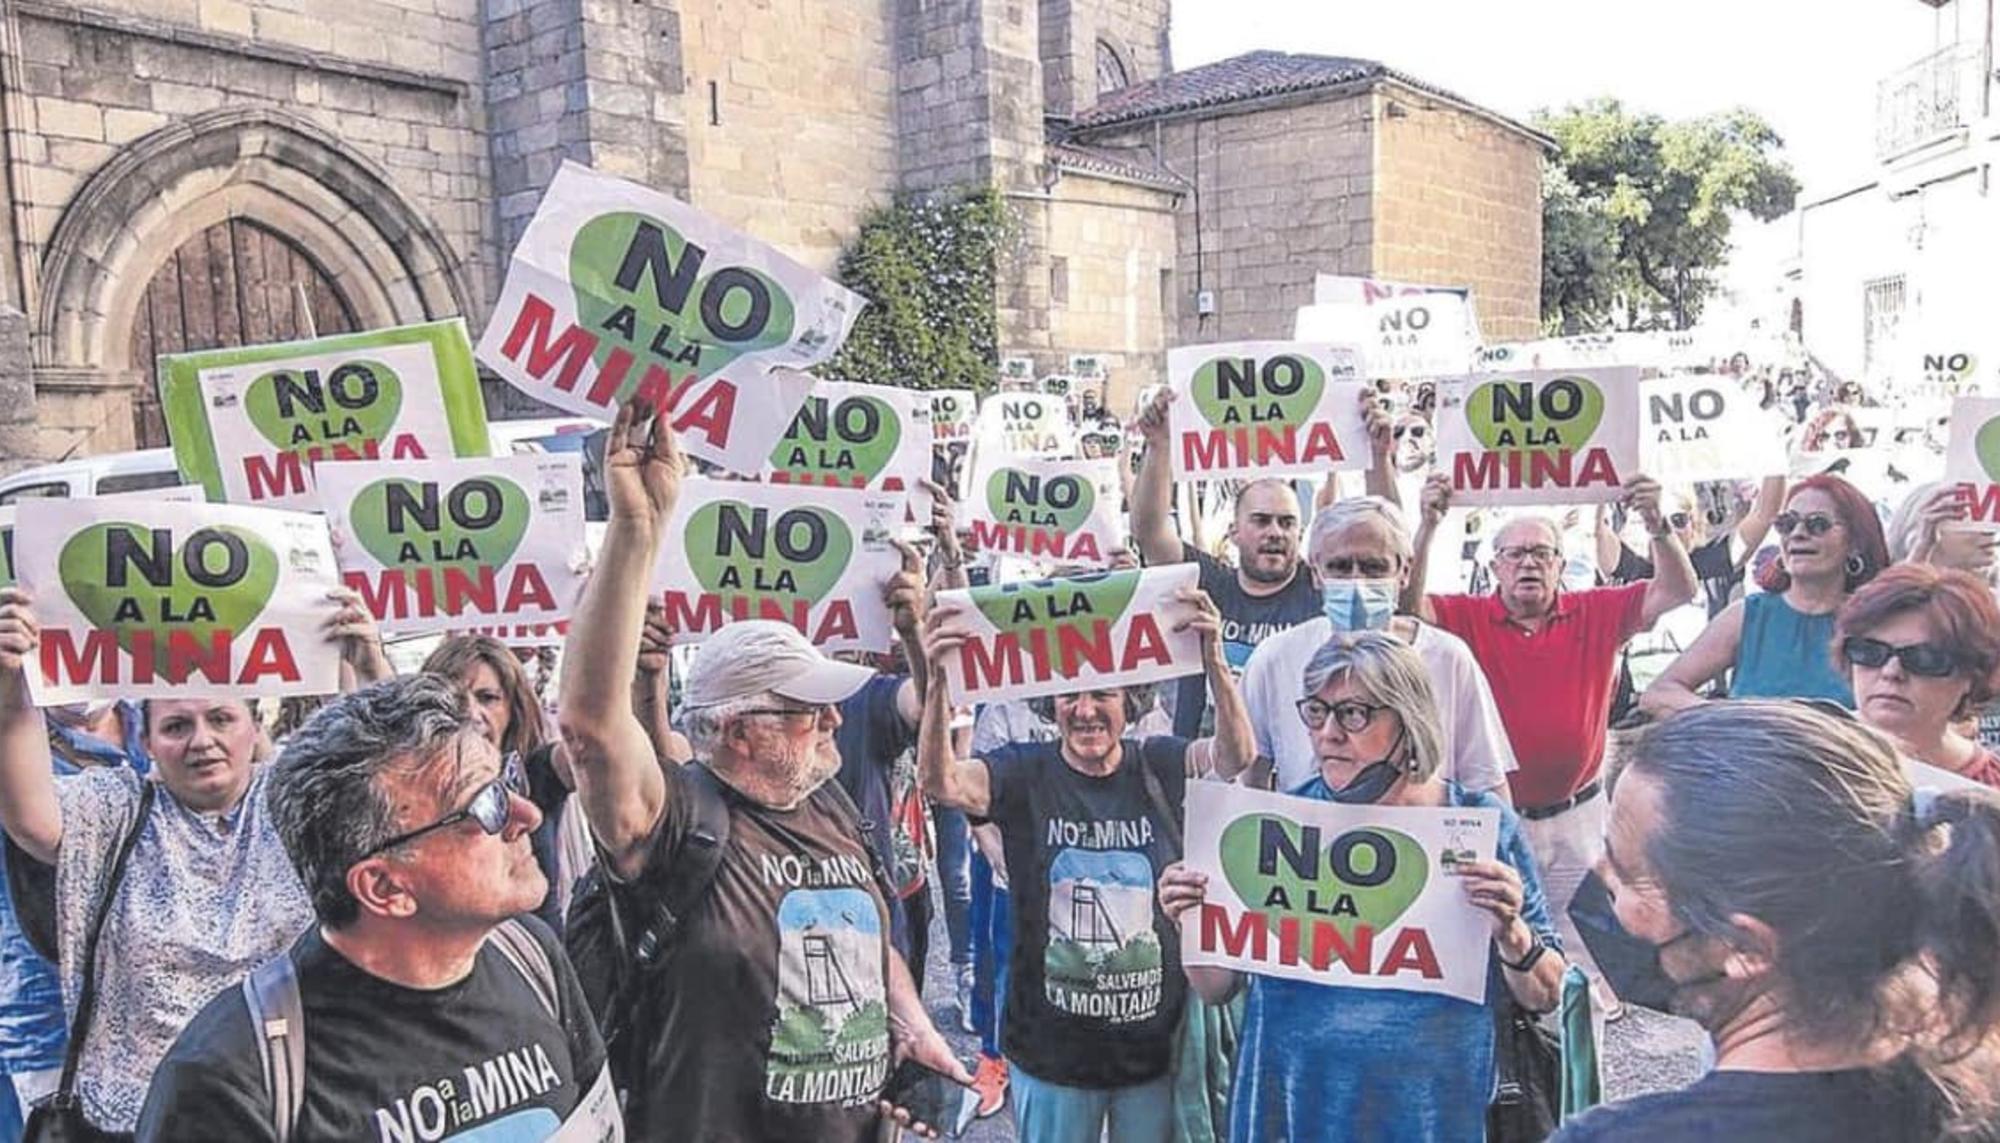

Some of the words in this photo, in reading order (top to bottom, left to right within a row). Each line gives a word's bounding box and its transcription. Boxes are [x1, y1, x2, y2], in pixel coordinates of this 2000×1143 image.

[614, 220, 771, 342] NO
[602, 305, 636, 341] A
[649, 323, 700, 368] LA
[1380, 306, 1430, 332] NO
[501, 293, 738, 450] MINA
[1482, 348, 1508, 362] NO
[1924, 353, 1969, 372] NO
[272, 364, 378, 418] NO
[1217, 353, 1304, 400] NO
[784, 396, 880, 444] NO
[1002, 401, 1042, 420] NO
[1223, 406, 1241, 424] A
[1250, 401, 1284, 423] LA
[1492, 378, 1584, 424] NO
[1649, 388, 1725, 425] NO
[292, 423, 312, 444] A
[321, 417, 362, 439] LA
[1182, 421, 1345, 471] MINA
[1497, 428, 1517, 447] A
[1526, 426, 1562, 446] LA
[1657, 429, 1672, 443] A
[1680, 425, 1709, 442] LA
[788, 447, 807, 467] A
[818, 448, 856, 469] LA
[1453, 446, 1621, 491] MINA
[386, 479, 503, 534] NO
[1005, 470, 1080, 509] NO
[716, 505, 828, 563] NO
[1007, 508, 1022, 523] A
[1031, 511, 1058, 527] LA
[106, 528, 249, 588] NO
[398, 541, 423, 563] A
[433, 538, 480, 562] LA
[972, 519, 1102, 562] MINA
[343, 563, 558, 621] MINA
[719, 565, 742, 589] A
[754, 567, 798, 593] LA
[113, 596, 145, 623] A
[161, 596, 217, 623] LA
[1012, 599, 1037, 624] A
[1048, 591, 1094, 619] LA
[40, 627, 302, 685] MINA
[961, 613, 1173, 692] MINA
[1047, 816, 1079, 846] NO
[1093, 816, 1155, 850] MINA
[760, 853, 803, 887] NO
[1259, 818, 1397, 888] NO
[1265, 886, 1292, 910] A
[1306, 892, 1359, 917] LA
[1200, 903, 1444, 980] MINA
[1044, 980, 1069, 1012] LA
[376, 1085, 446, 1143] NO
[437, 1078, 455, 1100] a
[451, 1099, 474, 1127] la
[463, 1043, 562, 1120] MINA
[766, 1069, 795, 1103] LA
